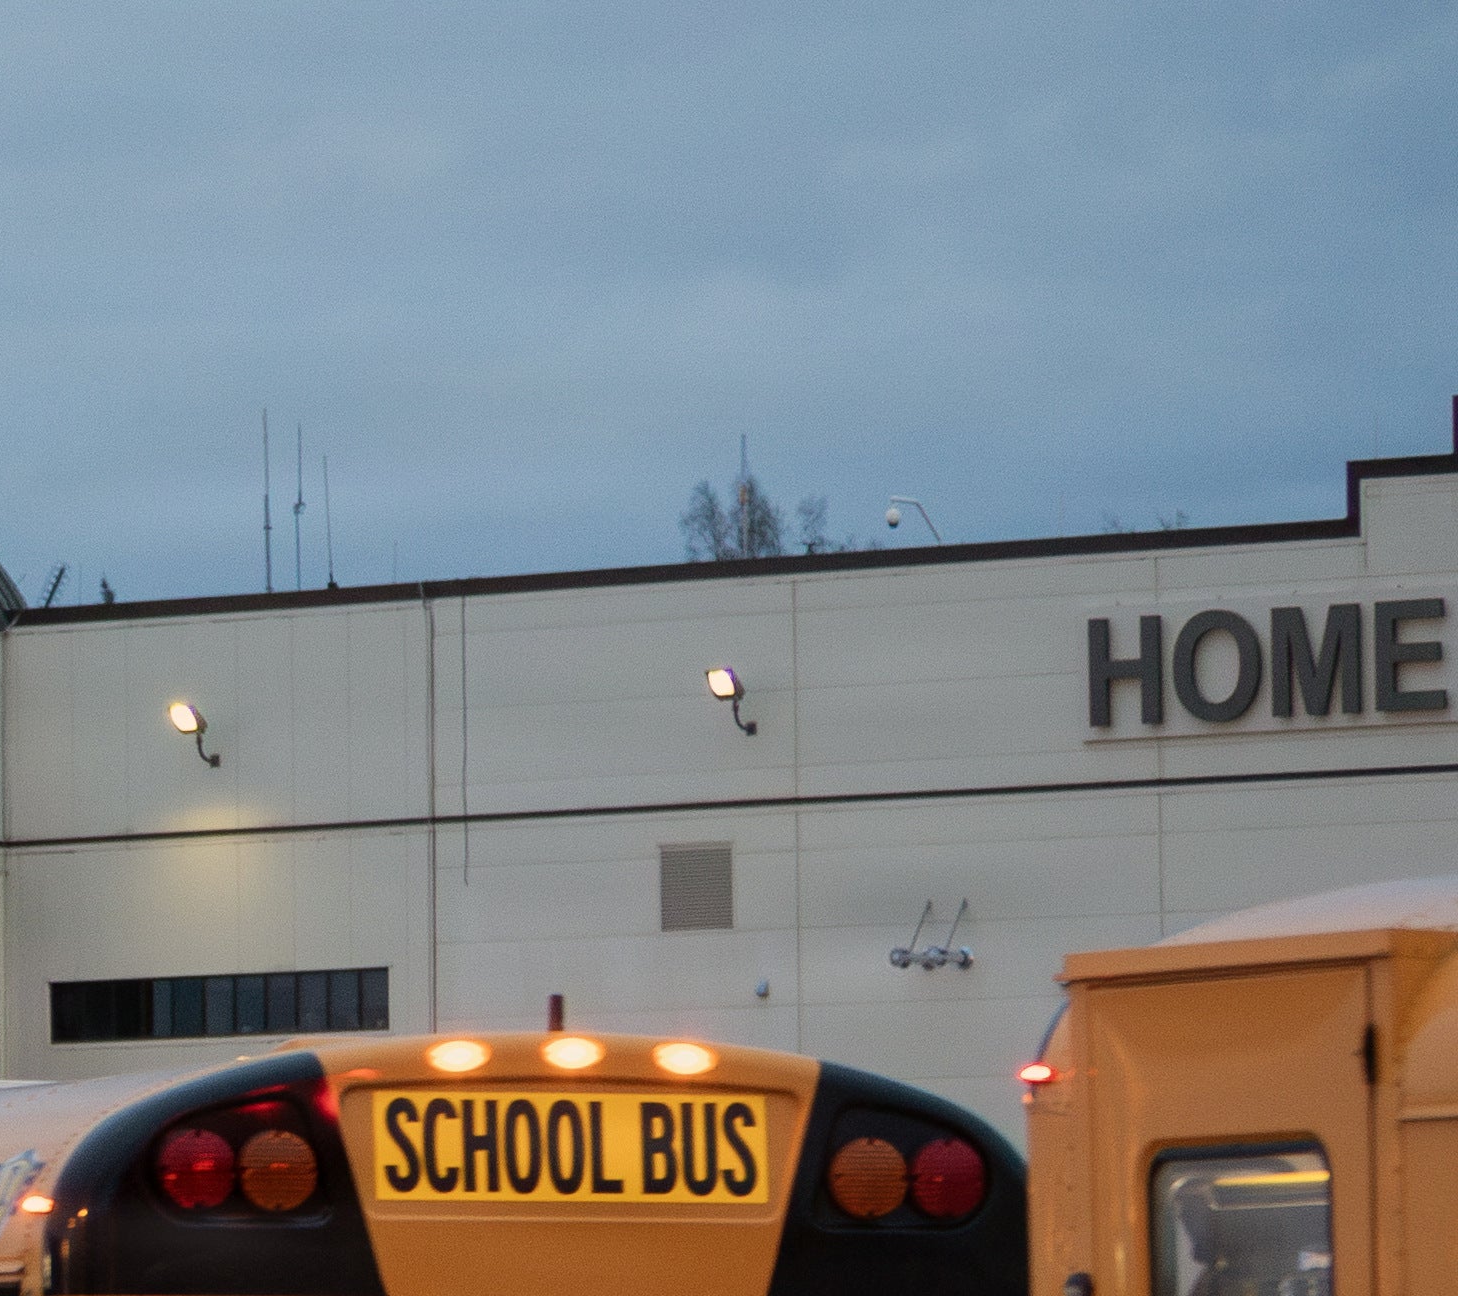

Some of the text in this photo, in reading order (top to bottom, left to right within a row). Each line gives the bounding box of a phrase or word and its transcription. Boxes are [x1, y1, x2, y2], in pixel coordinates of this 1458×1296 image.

[1087, 597, 1450, 728] HOME
[383, 1096, 758, 1198] SCHOOL BUS
